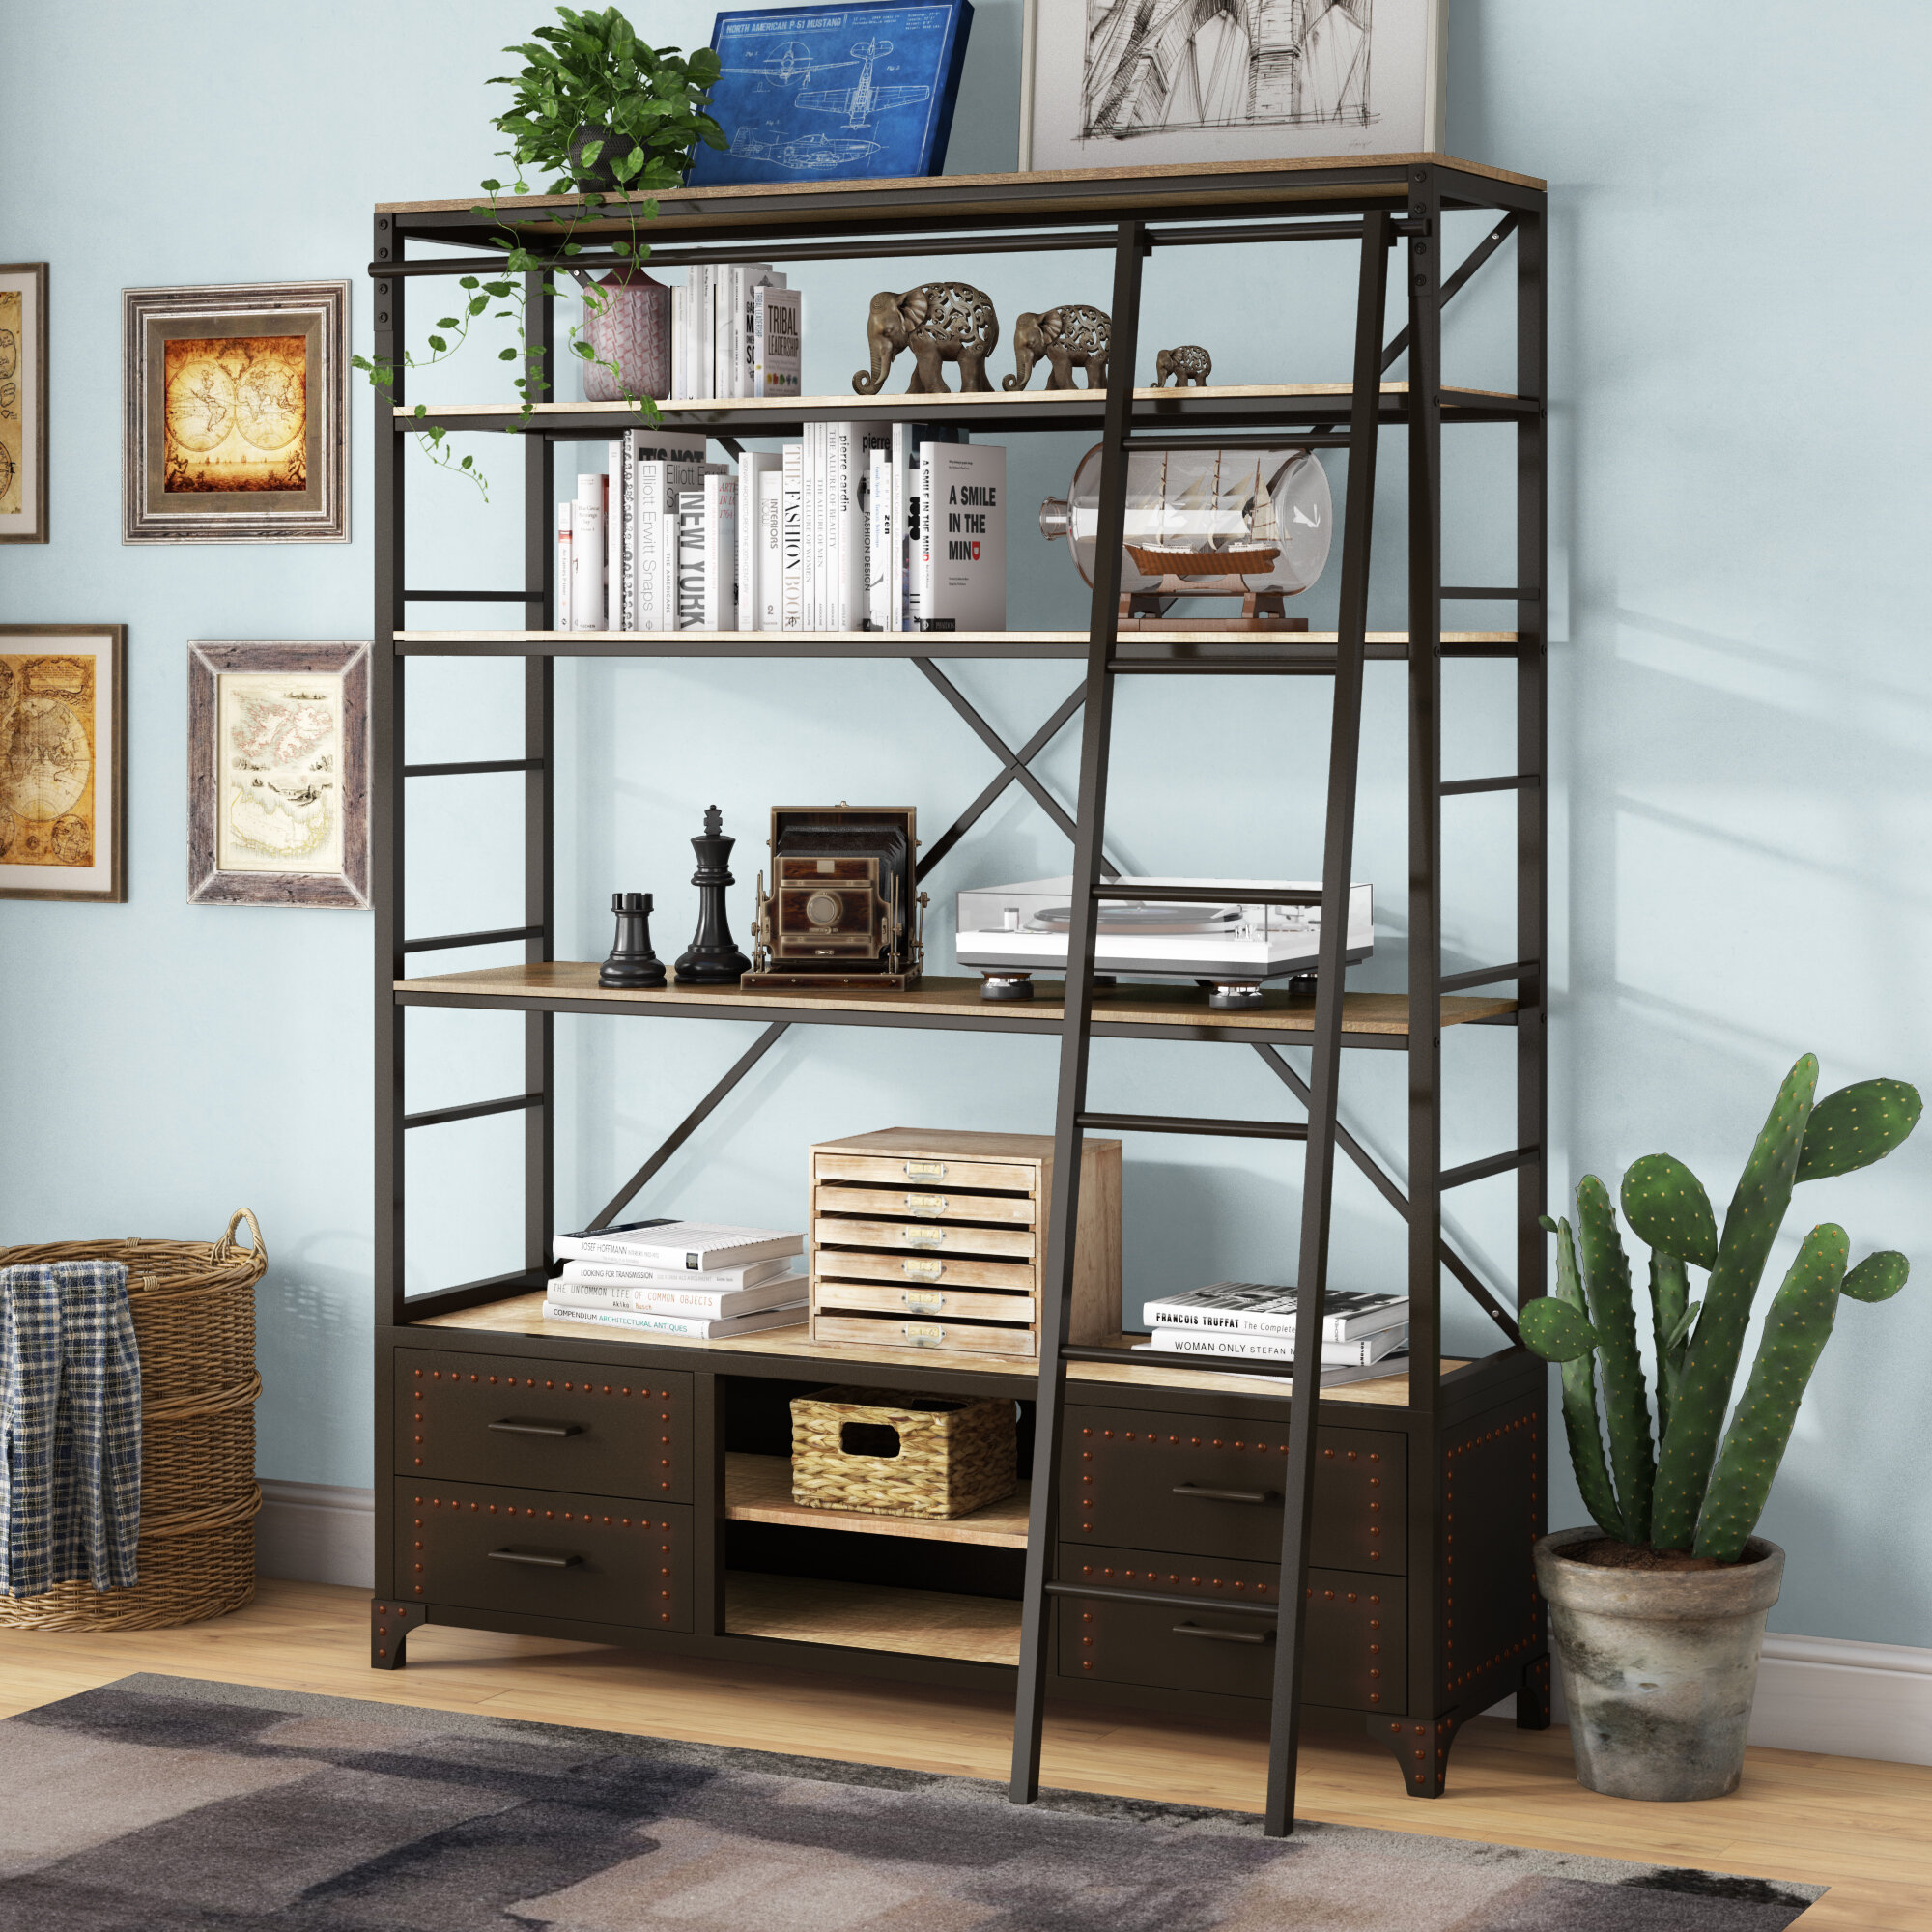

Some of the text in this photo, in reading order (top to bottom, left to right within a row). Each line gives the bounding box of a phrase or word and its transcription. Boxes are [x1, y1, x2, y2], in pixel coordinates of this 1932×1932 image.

[726, 24, 751, 34] NORTH
[752, 21, 787, 32] AMERICAN
[807, 17, 842, 28] MUSTANG
[768, 305, 798, 336] TRIBAL
[768, 335, 799, 357] LEADERSHIP
[862, 433, 891, 453] pierre
[671, 449, 704, 463] NOT
[666, 464, 695, 486] Elliott
[839, 435, 849, 512] pierre cardin
[829, 493, 837, 506] OF
[922, 501, 929, 512] IN
[949, 485, 996, 507] A SMILE
[949, 512, 986, 534] IN THE
[641, 465, 657, 611] Elliott Erwitt Snaps
[785, 447, 801, 627] THE FASHION BOOK
[805, 534, 812, 545] OF
[817, 534, 824, 545] OF
[949, 540, 981, 561] MIND
[680, 494, 705, 629] NEW YORK
[767, 605, 774, 615] 2
[581, 1242, 597, 1252] JOSEF
[597, 1244, 628, 1255] HOFFMANN
[581, 1269, 605, 1278] LOOKING
[615, 1270, 654, 1279] TRANSMISSION
[554, 1283, 713, 1307] THE UNCOMMON LIFE OF COMMON OBJECTS
[553, 1308, 688, 1333] COMPENDIUM ARCHITECTURAL ANTIQUES
[1156, 1312, 1295, 1334] FRANCOIS TRUFFAT The Complete
[1175, 1341, 1215, 1351] WOMAN
[1219, 1343, 1246, 1353] ONLY
[1250, 1346, 1286, 1355] STEFAN
